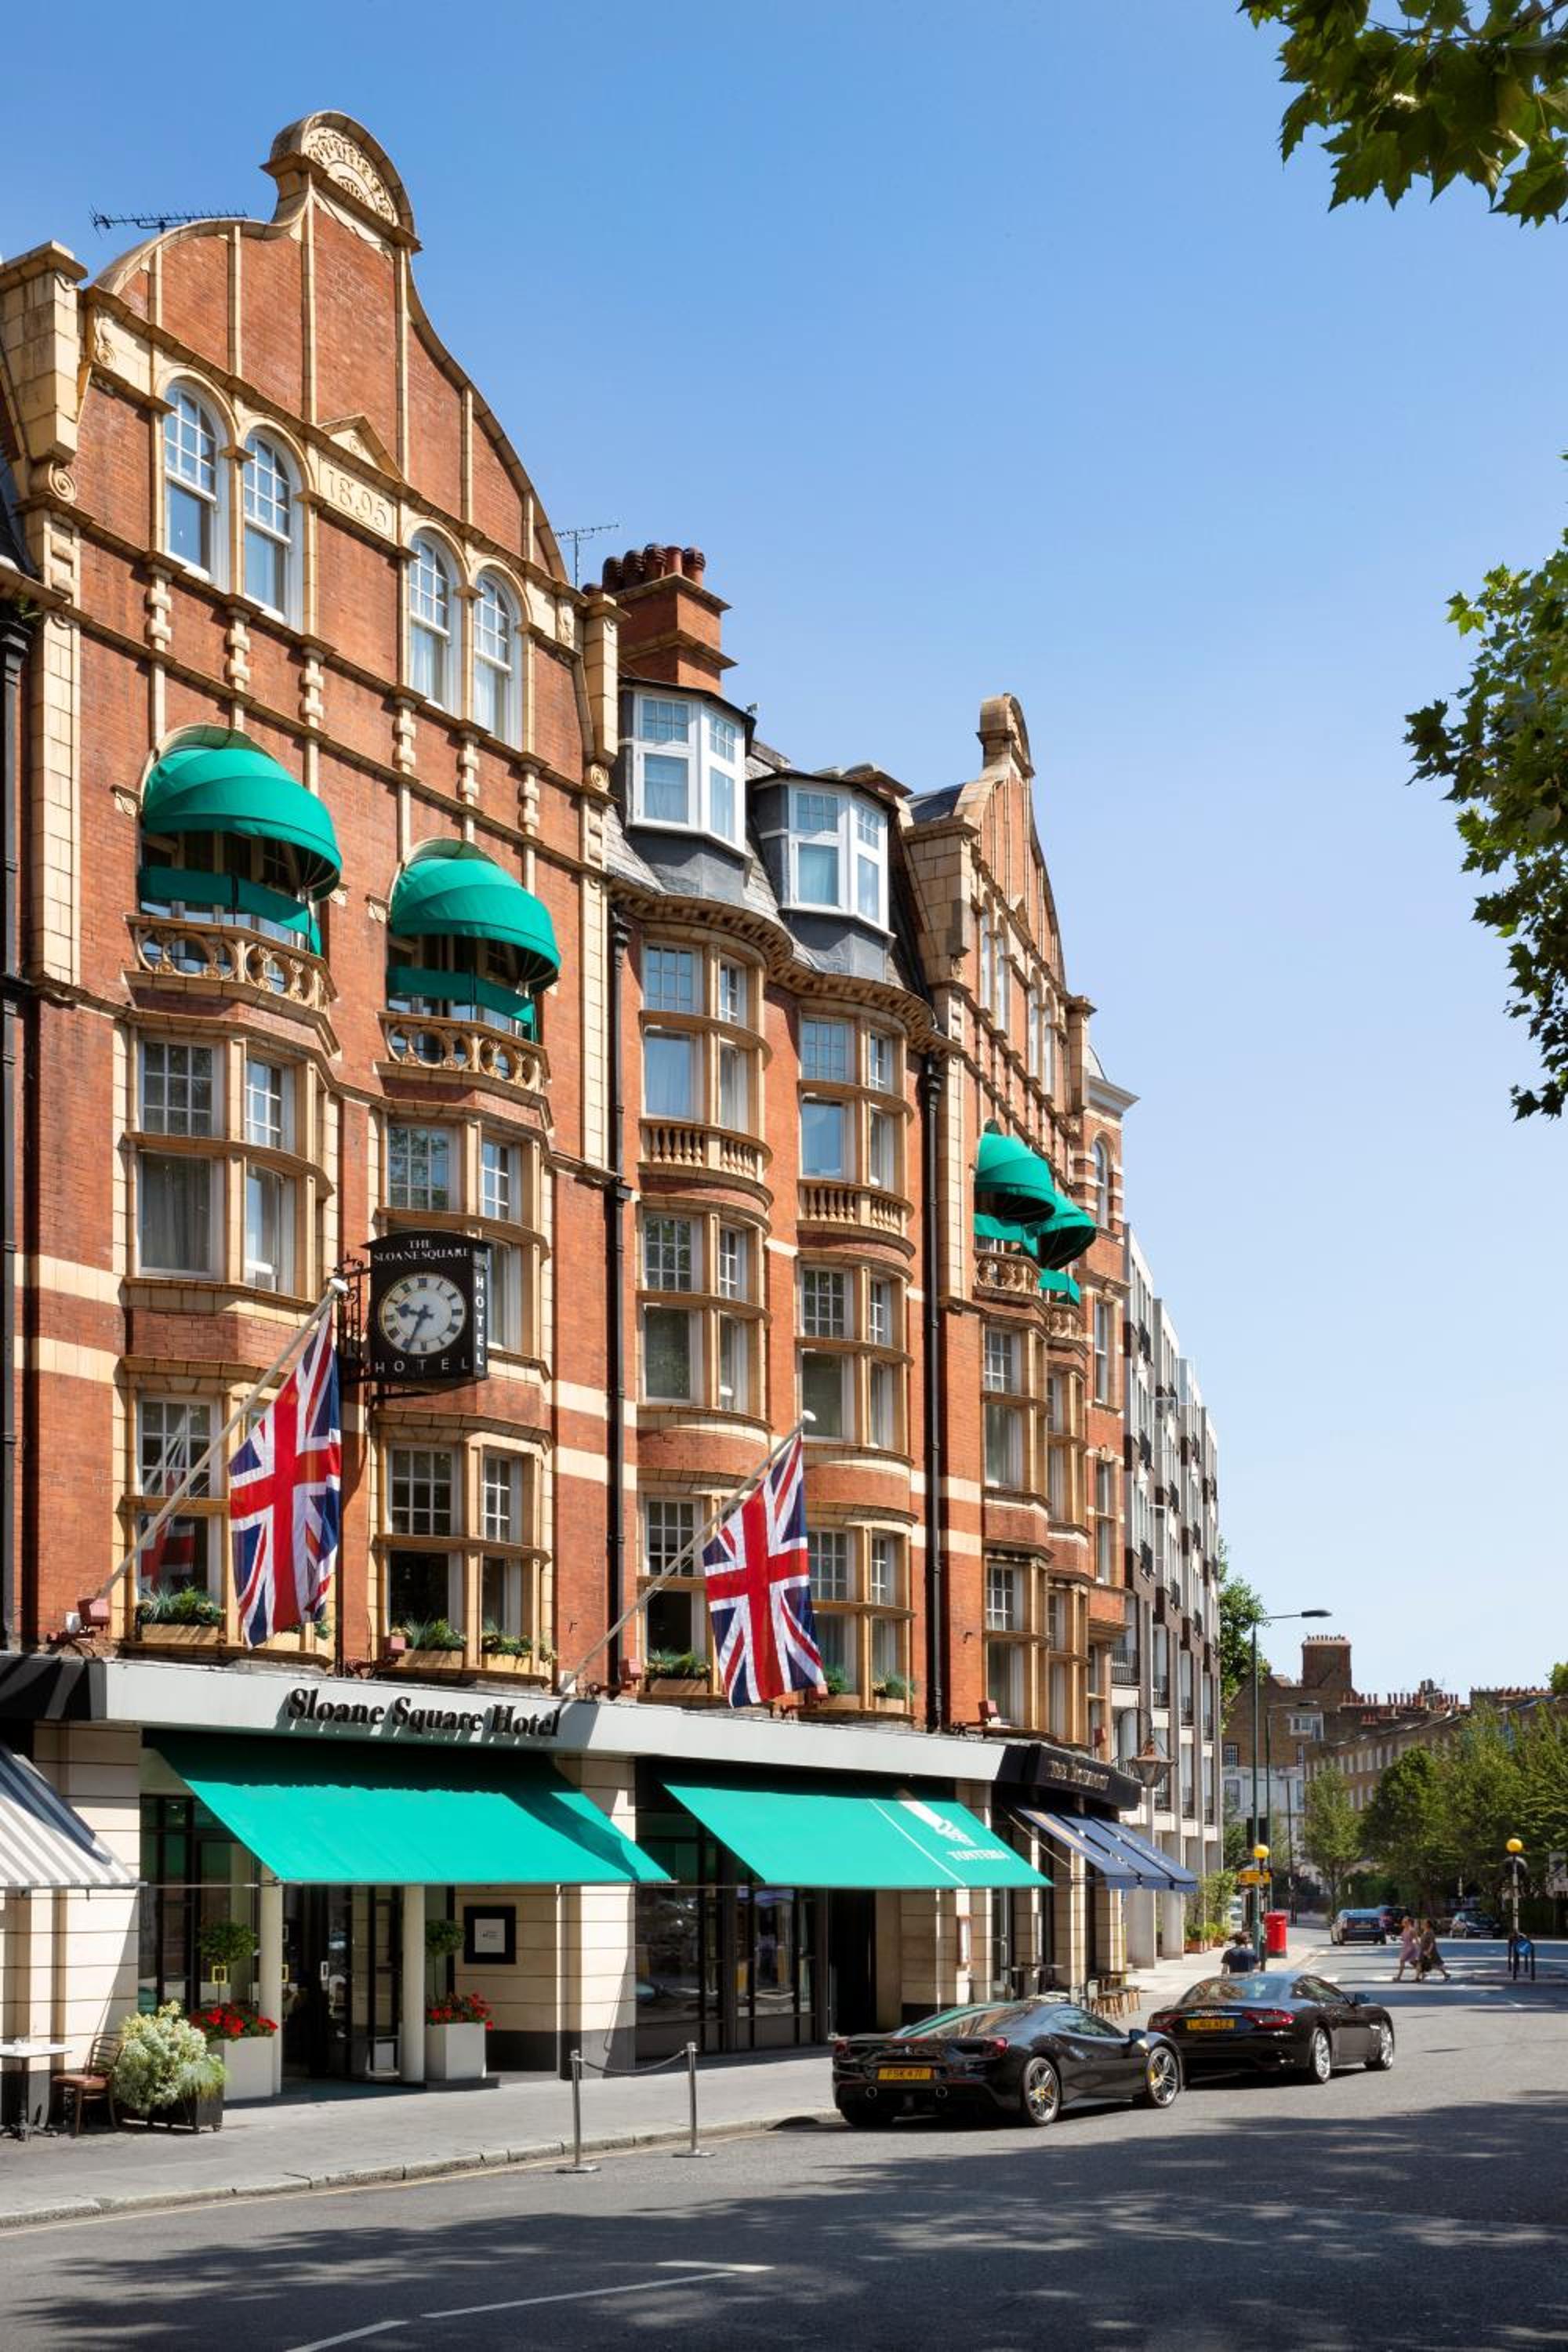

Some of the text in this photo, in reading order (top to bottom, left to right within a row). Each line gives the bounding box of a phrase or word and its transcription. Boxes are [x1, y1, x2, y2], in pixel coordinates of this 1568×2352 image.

[327, 470, 387, 528] 1895
[420, 1247, 469, 1260] SQUARE
[475, 1276, 485, 1365] HOTEL
[375, 1359, 470, 1374] HOTEL
[288, 1688, 561, 1737] Sloane Square Hotel
